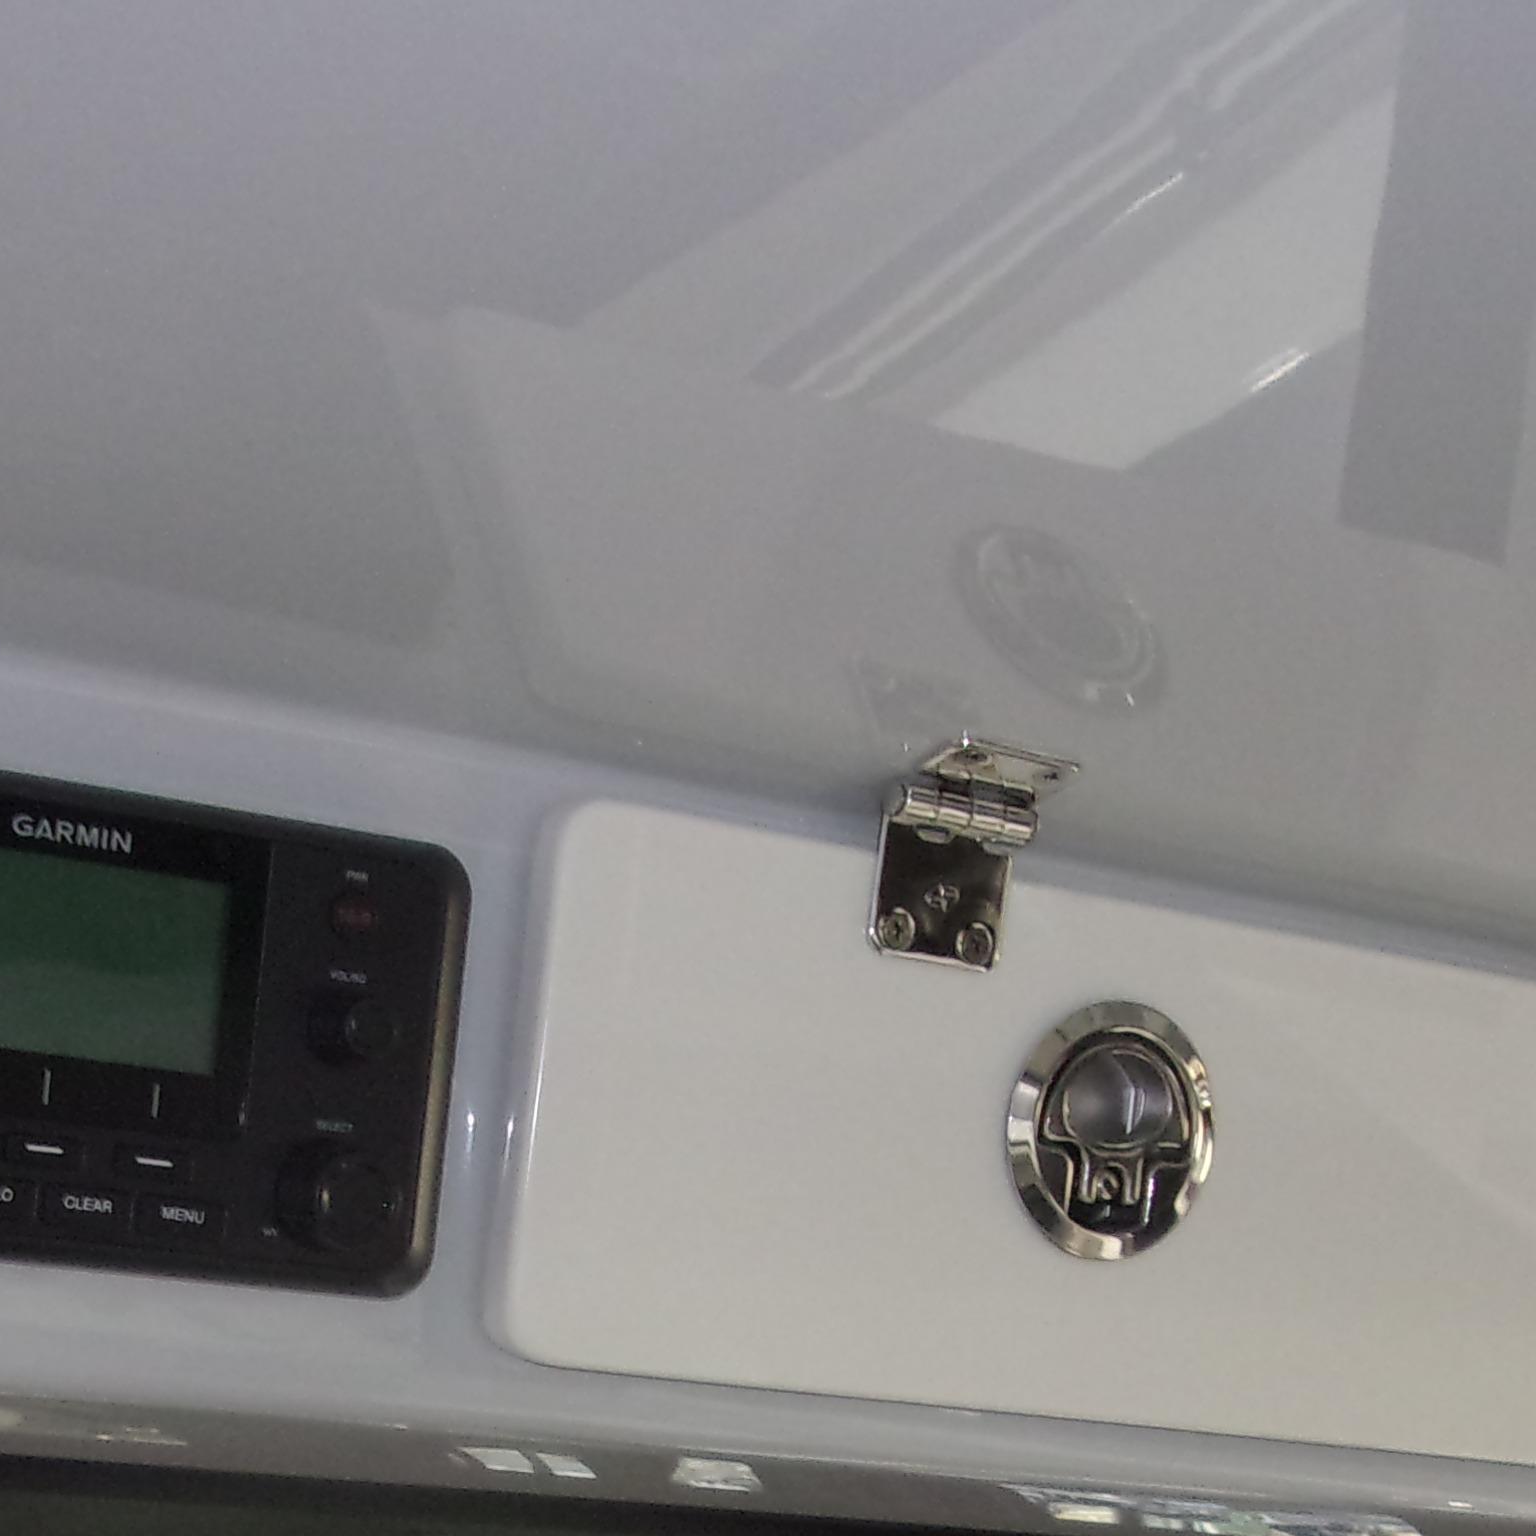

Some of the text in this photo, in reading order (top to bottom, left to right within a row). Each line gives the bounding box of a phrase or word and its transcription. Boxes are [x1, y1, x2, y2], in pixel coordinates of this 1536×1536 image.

[11, 813, 132, 854] GARMIN
[62, 1194, 114, 1214] CLEAR
[160, 1205, 206, 1225] MENU
